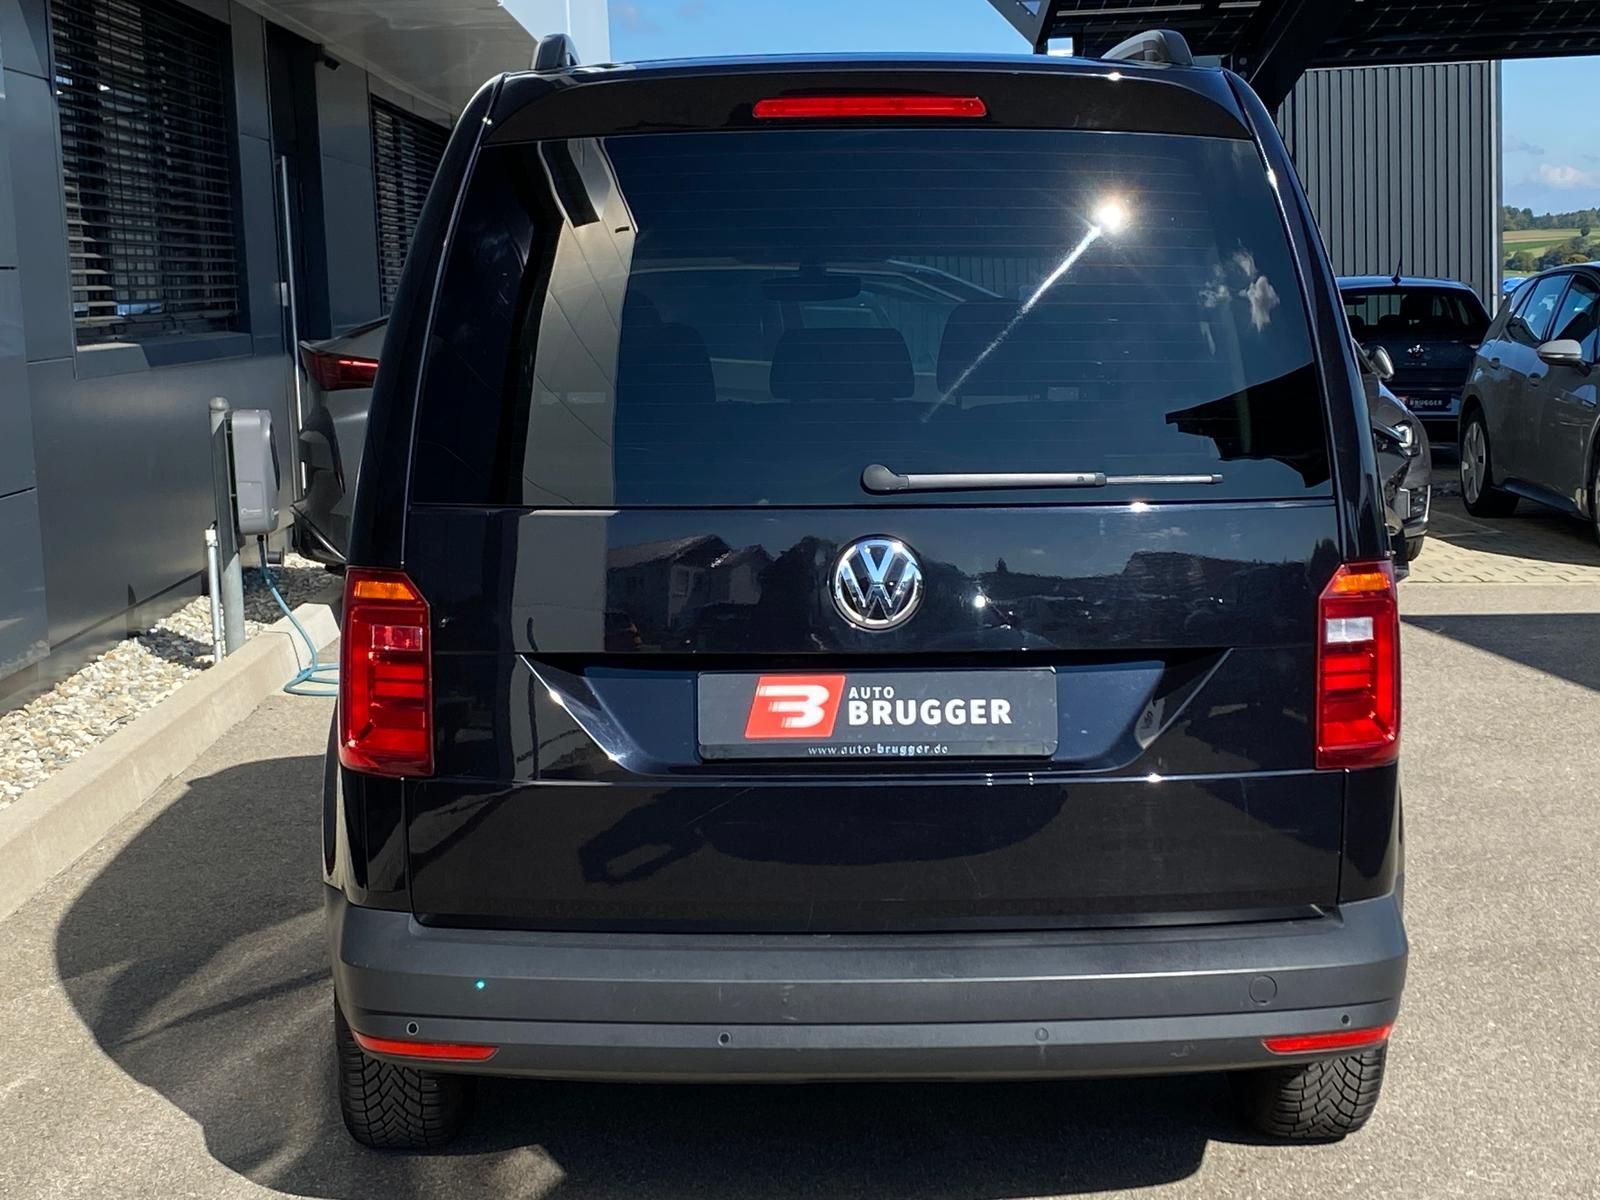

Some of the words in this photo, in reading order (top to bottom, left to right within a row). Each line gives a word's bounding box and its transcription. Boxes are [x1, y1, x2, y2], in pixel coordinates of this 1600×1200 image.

[848, 686, 895, 700] AUTO
[848, 698, 1012, 726] BRUGGER
[807, 742, 949, 756] www.auto-brugger.de
